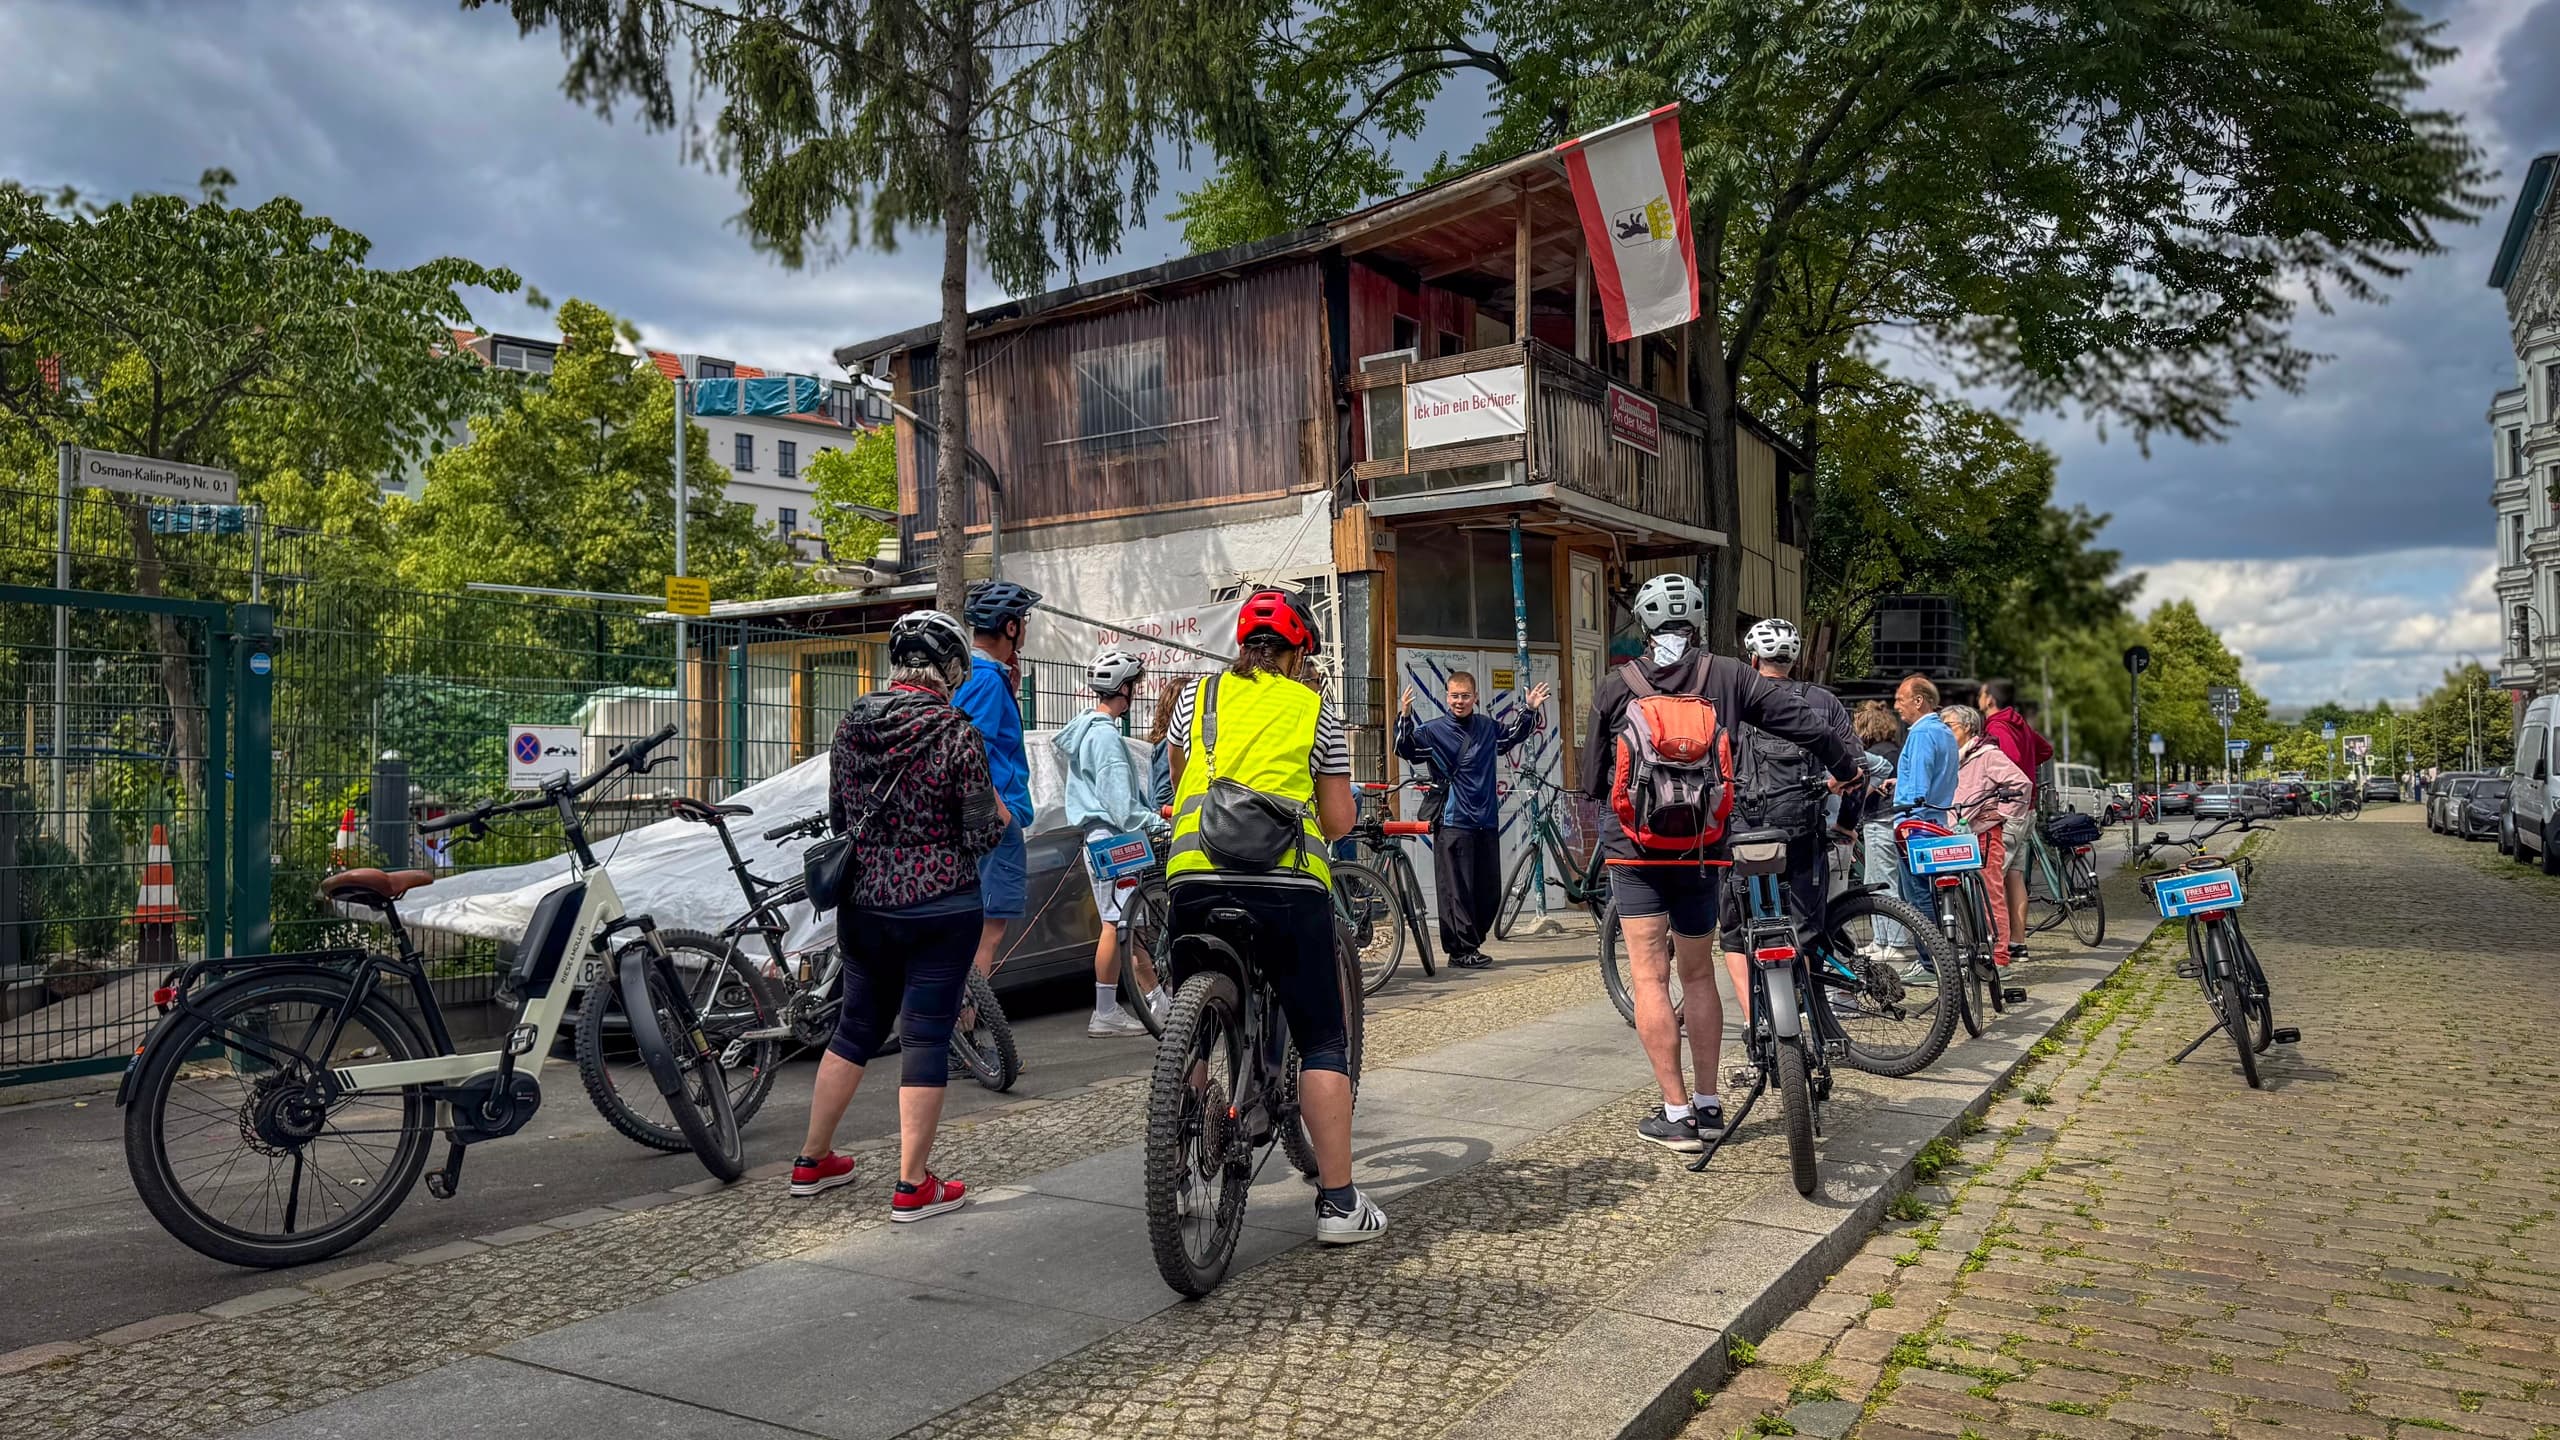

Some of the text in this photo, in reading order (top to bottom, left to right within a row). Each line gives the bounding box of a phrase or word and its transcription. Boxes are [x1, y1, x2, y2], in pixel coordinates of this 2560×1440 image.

[1414, 392, 1519, 420] Ick bin ein Berliner.
[1613, 408, 1623, 423] An
[1624, 414, 1635, 428] der
[1636, 418, 1656, 438] Mauer
[193, 476, 209, 490] Nr.
[1097, 630, 1120, 646] WO
[1170, 617, 1202, 637] IHR,
[2187, 884, 2228, 896] FREE BERLIN
